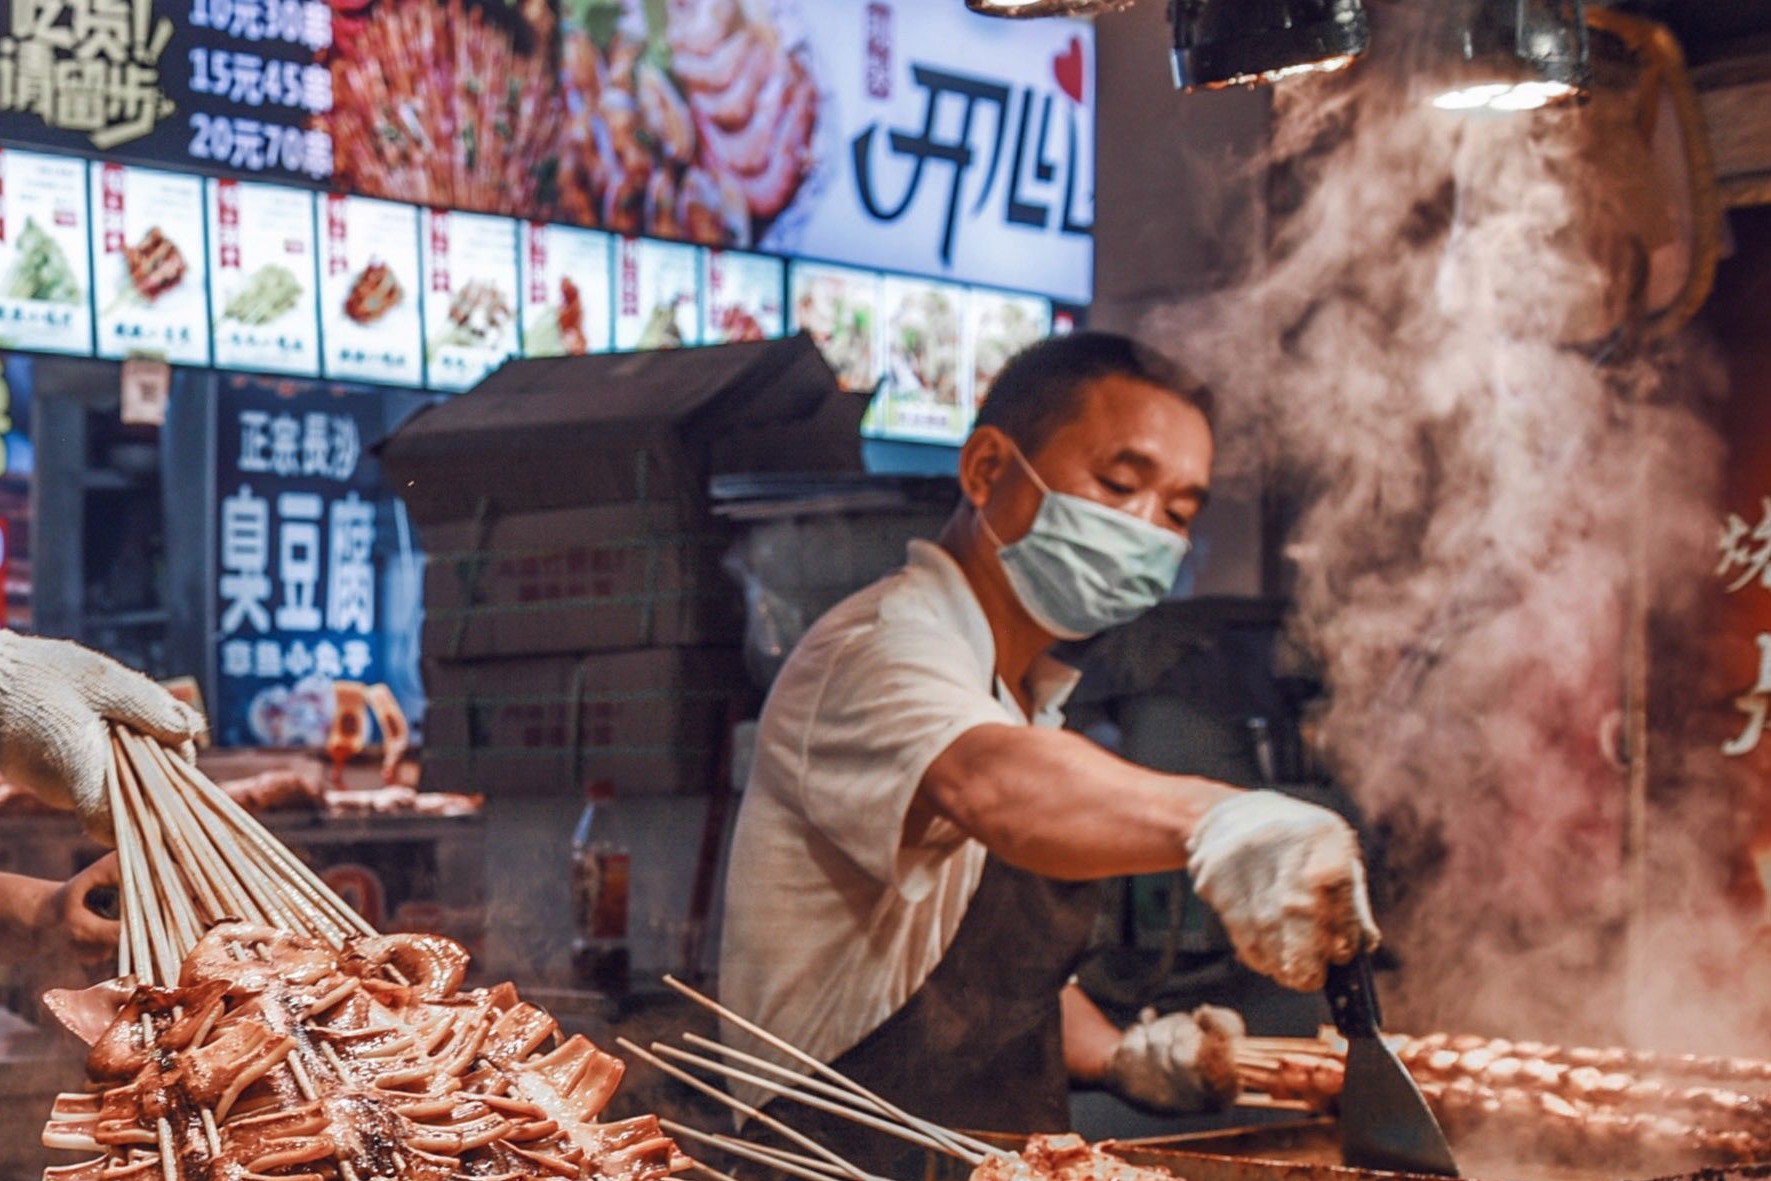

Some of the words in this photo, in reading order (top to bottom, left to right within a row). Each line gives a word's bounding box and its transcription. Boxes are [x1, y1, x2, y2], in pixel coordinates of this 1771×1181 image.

[189, 48, 334, 115] 15元45串
[189, 112, 334, 181] 20元70串
[219, 483, 377, 635] 臭豆腐
